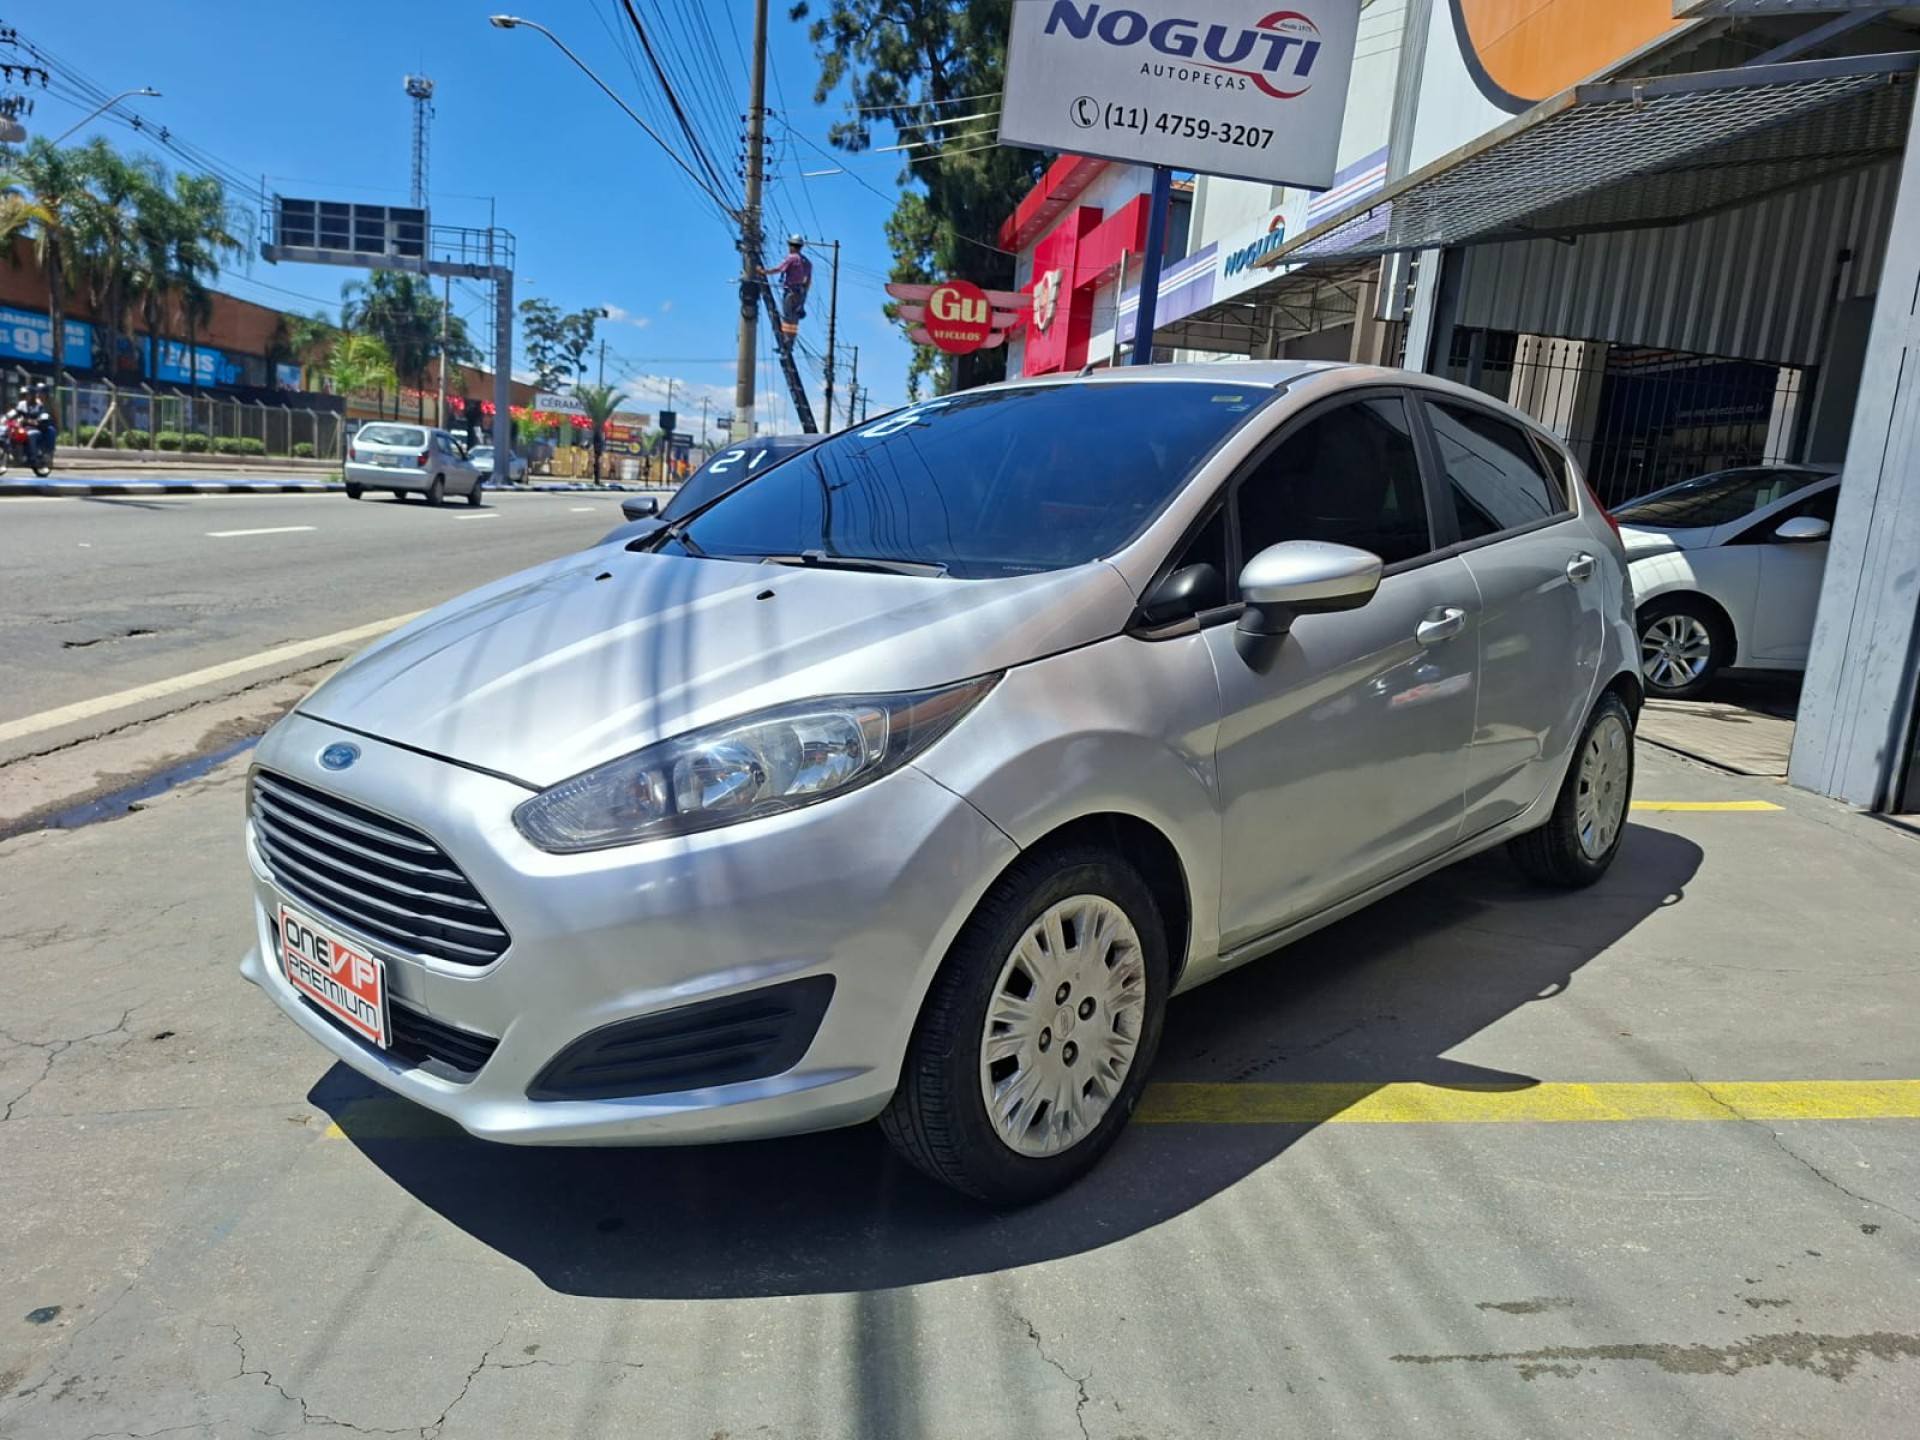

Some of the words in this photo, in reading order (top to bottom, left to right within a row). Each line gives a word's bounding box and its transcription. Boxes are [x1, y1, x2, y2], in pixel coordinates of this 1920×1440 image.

[1044, 0, 1321, 77] NOGUTI
[1140, 61, 1247, 91] AUTOPEÇAS
[1104, 102, 1149, 135] (11)
[1155, 112, 1274, 150] 4759-3207
[930, 287, 987, 324] Gu
[288, 953, 378, 1029] PREMIUM
